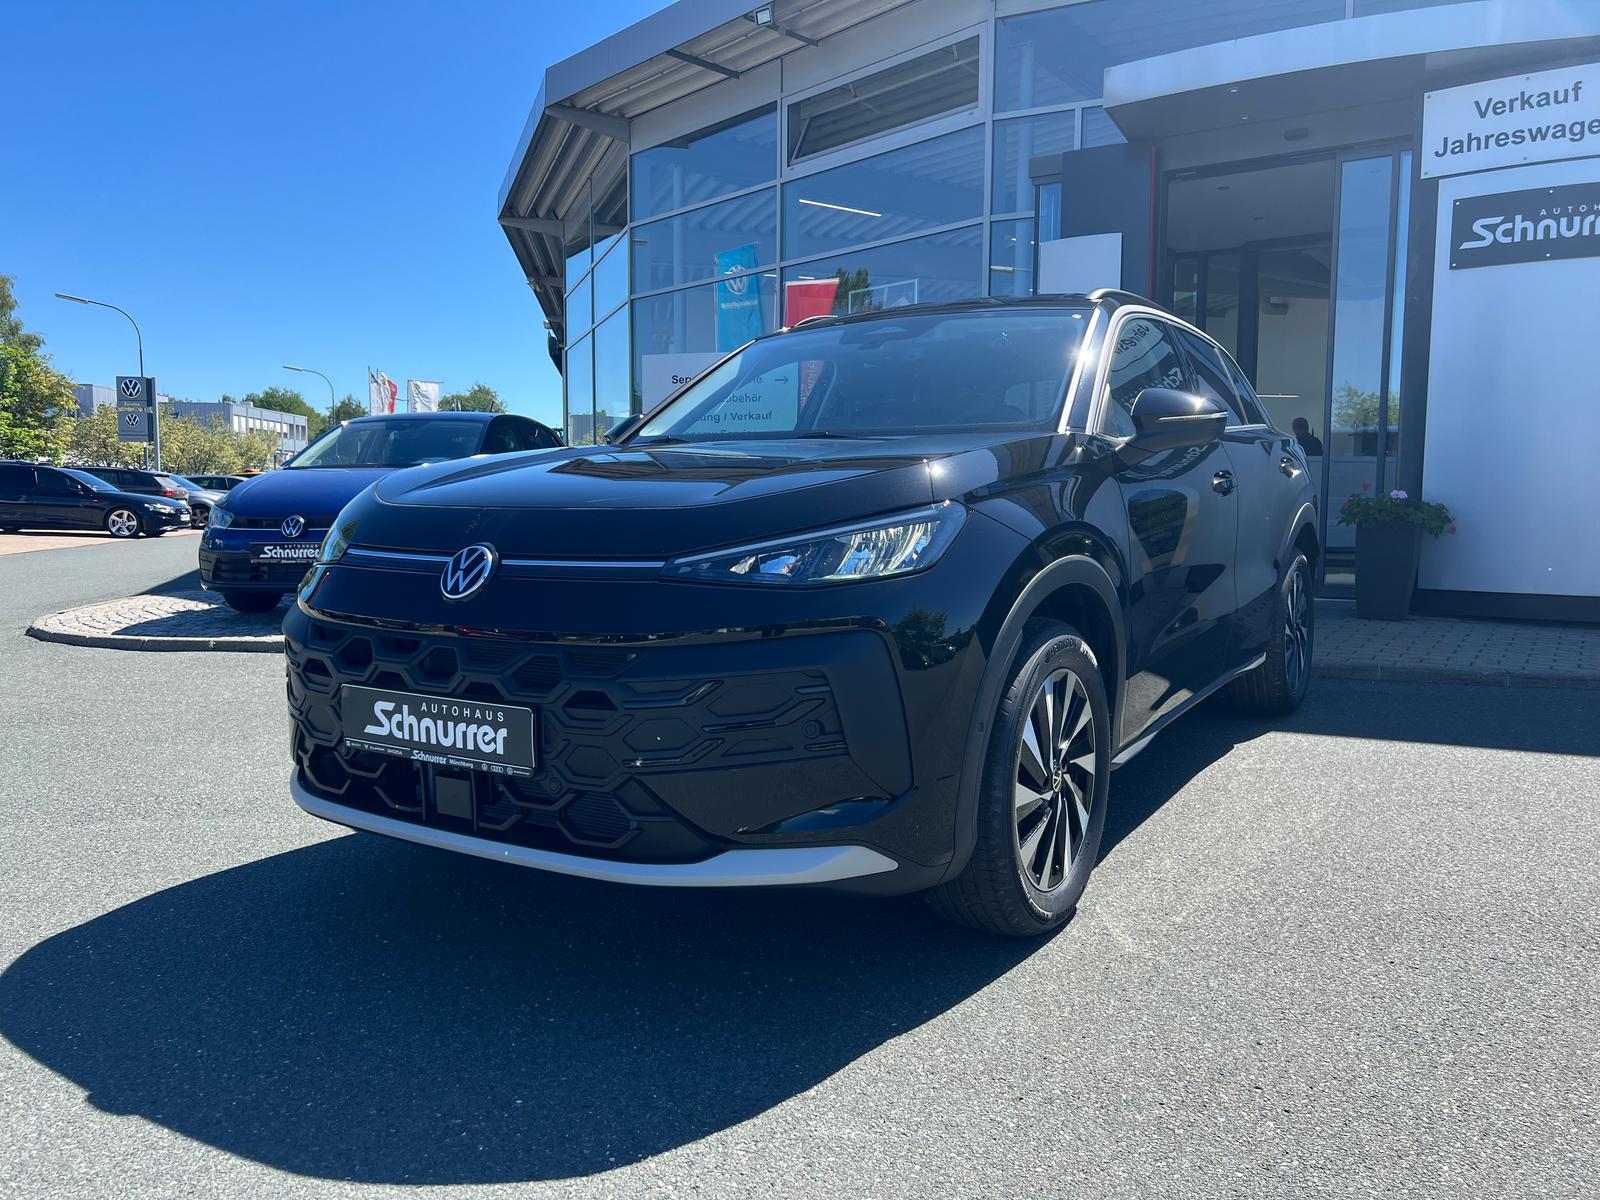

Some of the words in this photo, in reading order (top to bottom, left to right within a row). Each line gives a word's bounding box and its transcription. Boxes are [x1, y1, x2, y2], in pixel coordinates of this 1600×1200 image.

[1474, 80, 1584, 119] Verkauf
[1434, 118, 1600, 158] Jahreswage
[723, 393, 762, 403] ubehör
[730, 410, 773, 421] Verkauf
[420, 701, 505, 722] AUTOHAUS
[363, 699, 508, 756] Schnurrer
[410, 749, 448, 765] Schnurrer
